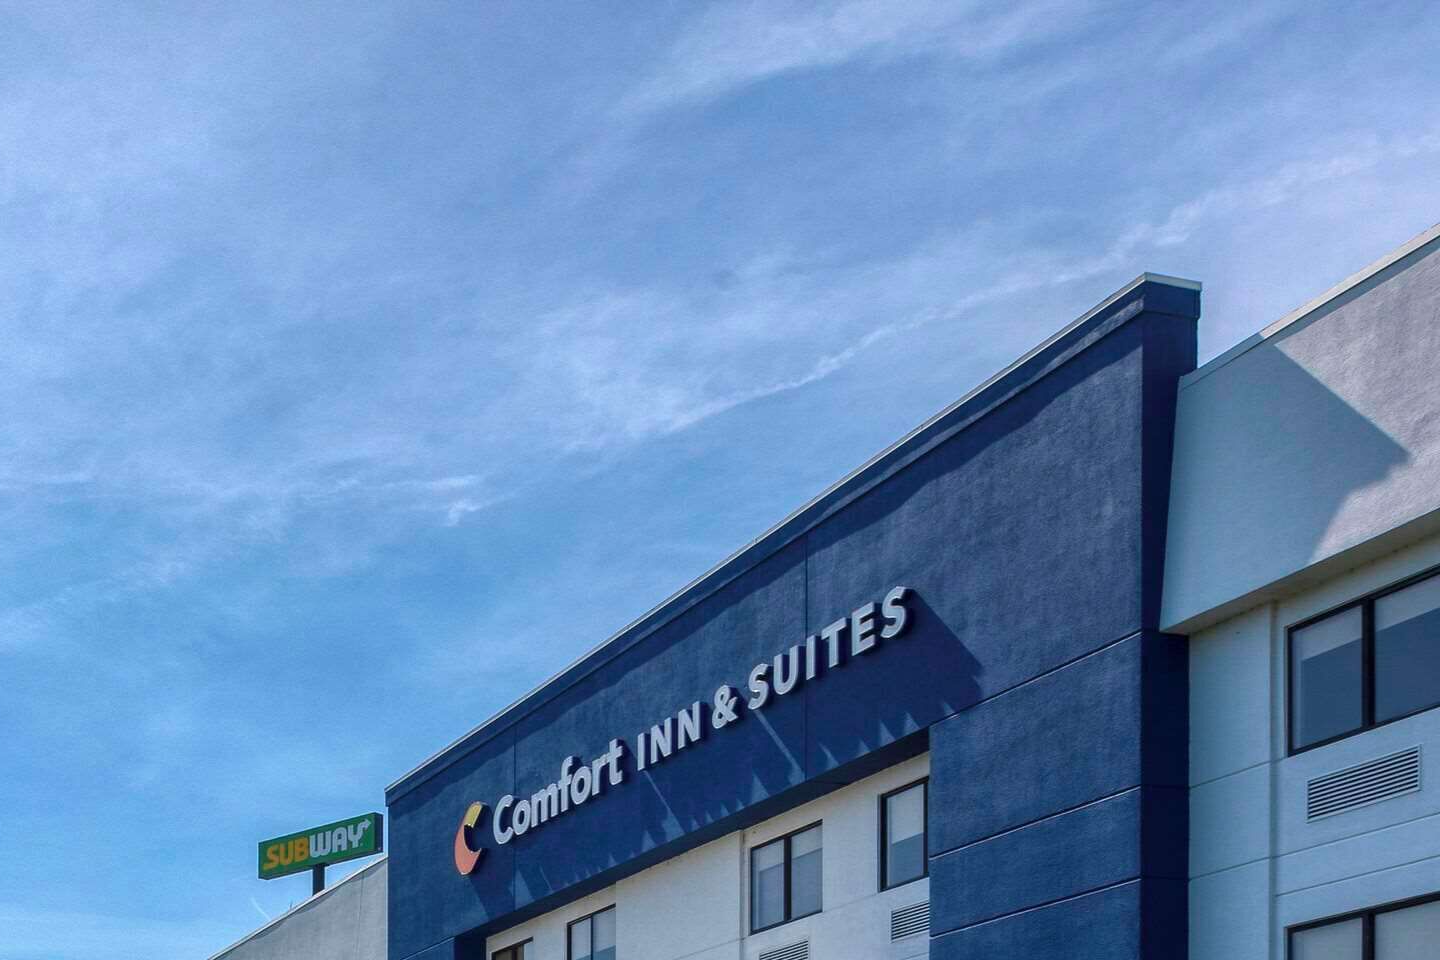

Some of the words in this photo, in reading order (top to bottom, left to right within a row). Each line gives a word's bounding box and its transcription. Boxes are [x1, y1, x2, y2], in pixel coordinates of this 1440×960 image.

[493, 738, 623, 845] Comfort
[637, 701, 702, 771] INN
[712, 685, 738, 729] &
[748, 586, 907, 710] SUITES
[263, 819, 371, 871] SUBWAY
